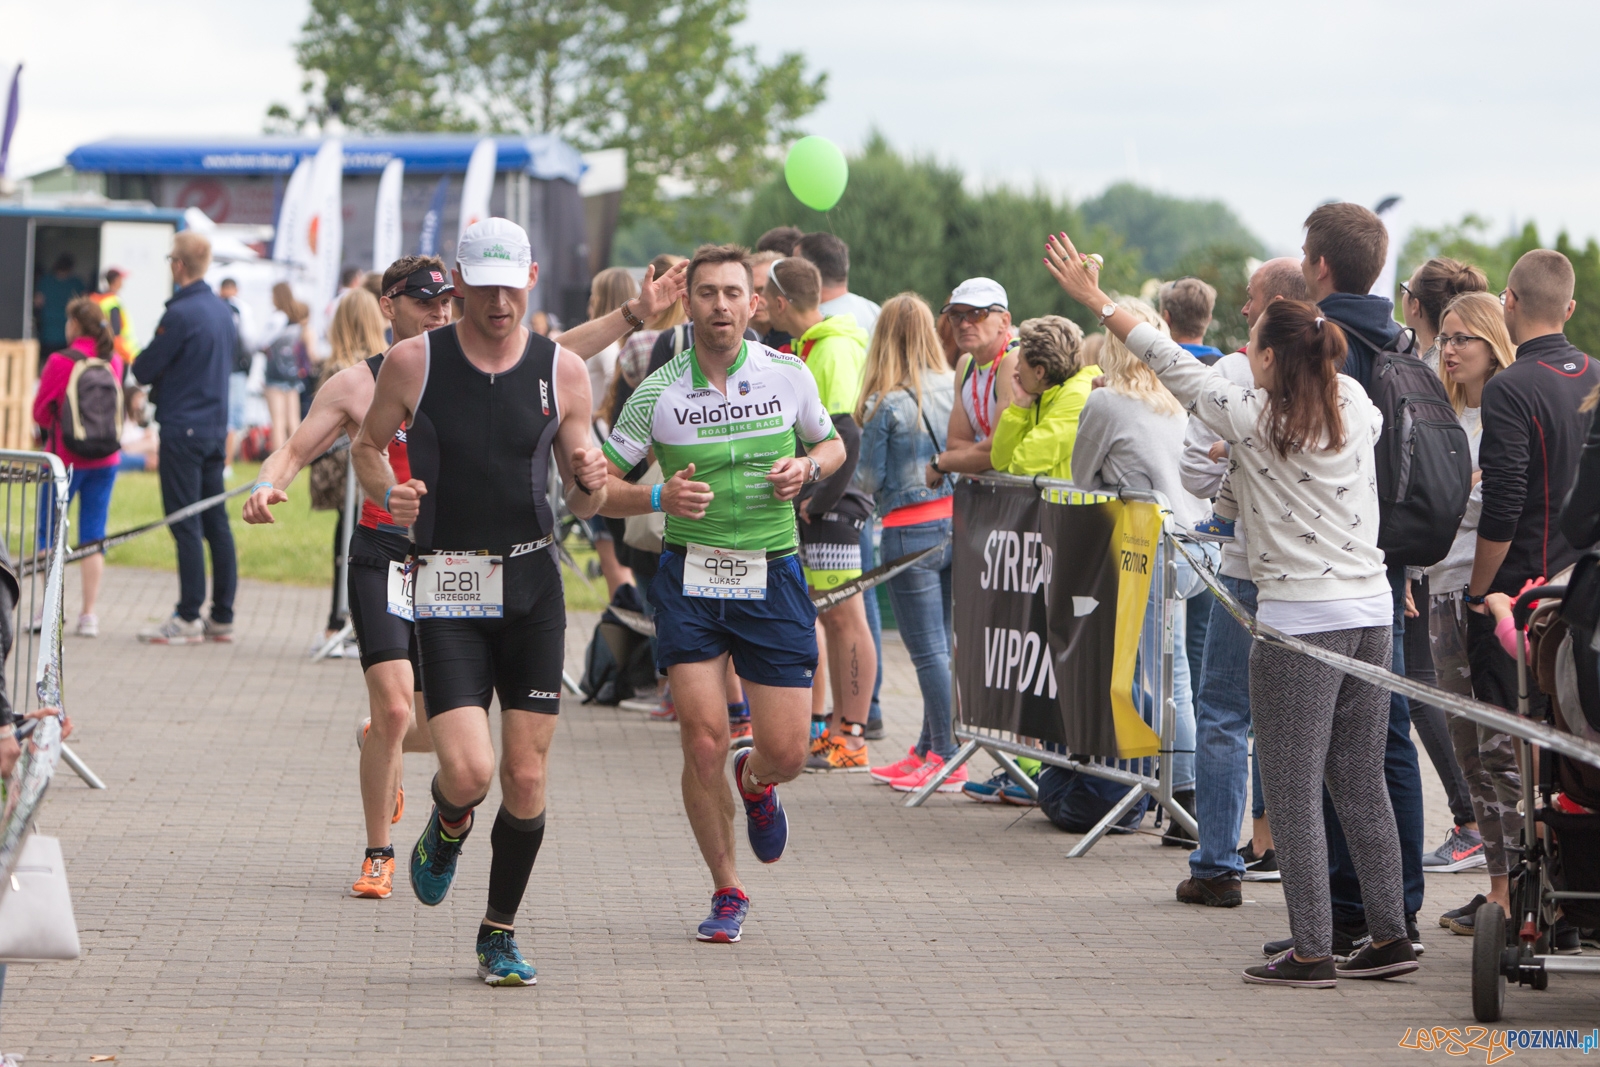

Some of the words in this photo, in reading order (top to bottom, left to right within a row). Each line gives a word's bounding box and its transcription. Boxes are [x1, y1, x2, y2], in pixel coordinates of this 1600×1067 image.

[483, 251, 511, 261] SŁAWA
[686, 390, 711, 400] KWIATO
[673, 395, 782, 425] VeloToruń
[701, 427, 727, 436] ROAD
[730, 424, 752, 432] BIKE
[756, 418, 780, 428] RACE
[704, 557, 748, 577] 995
[435, 571, 480, 592] 1281
[708, 576, 741, 585] ŁUKASZ
[434, 593, 482, 601] GRZEGORZ
